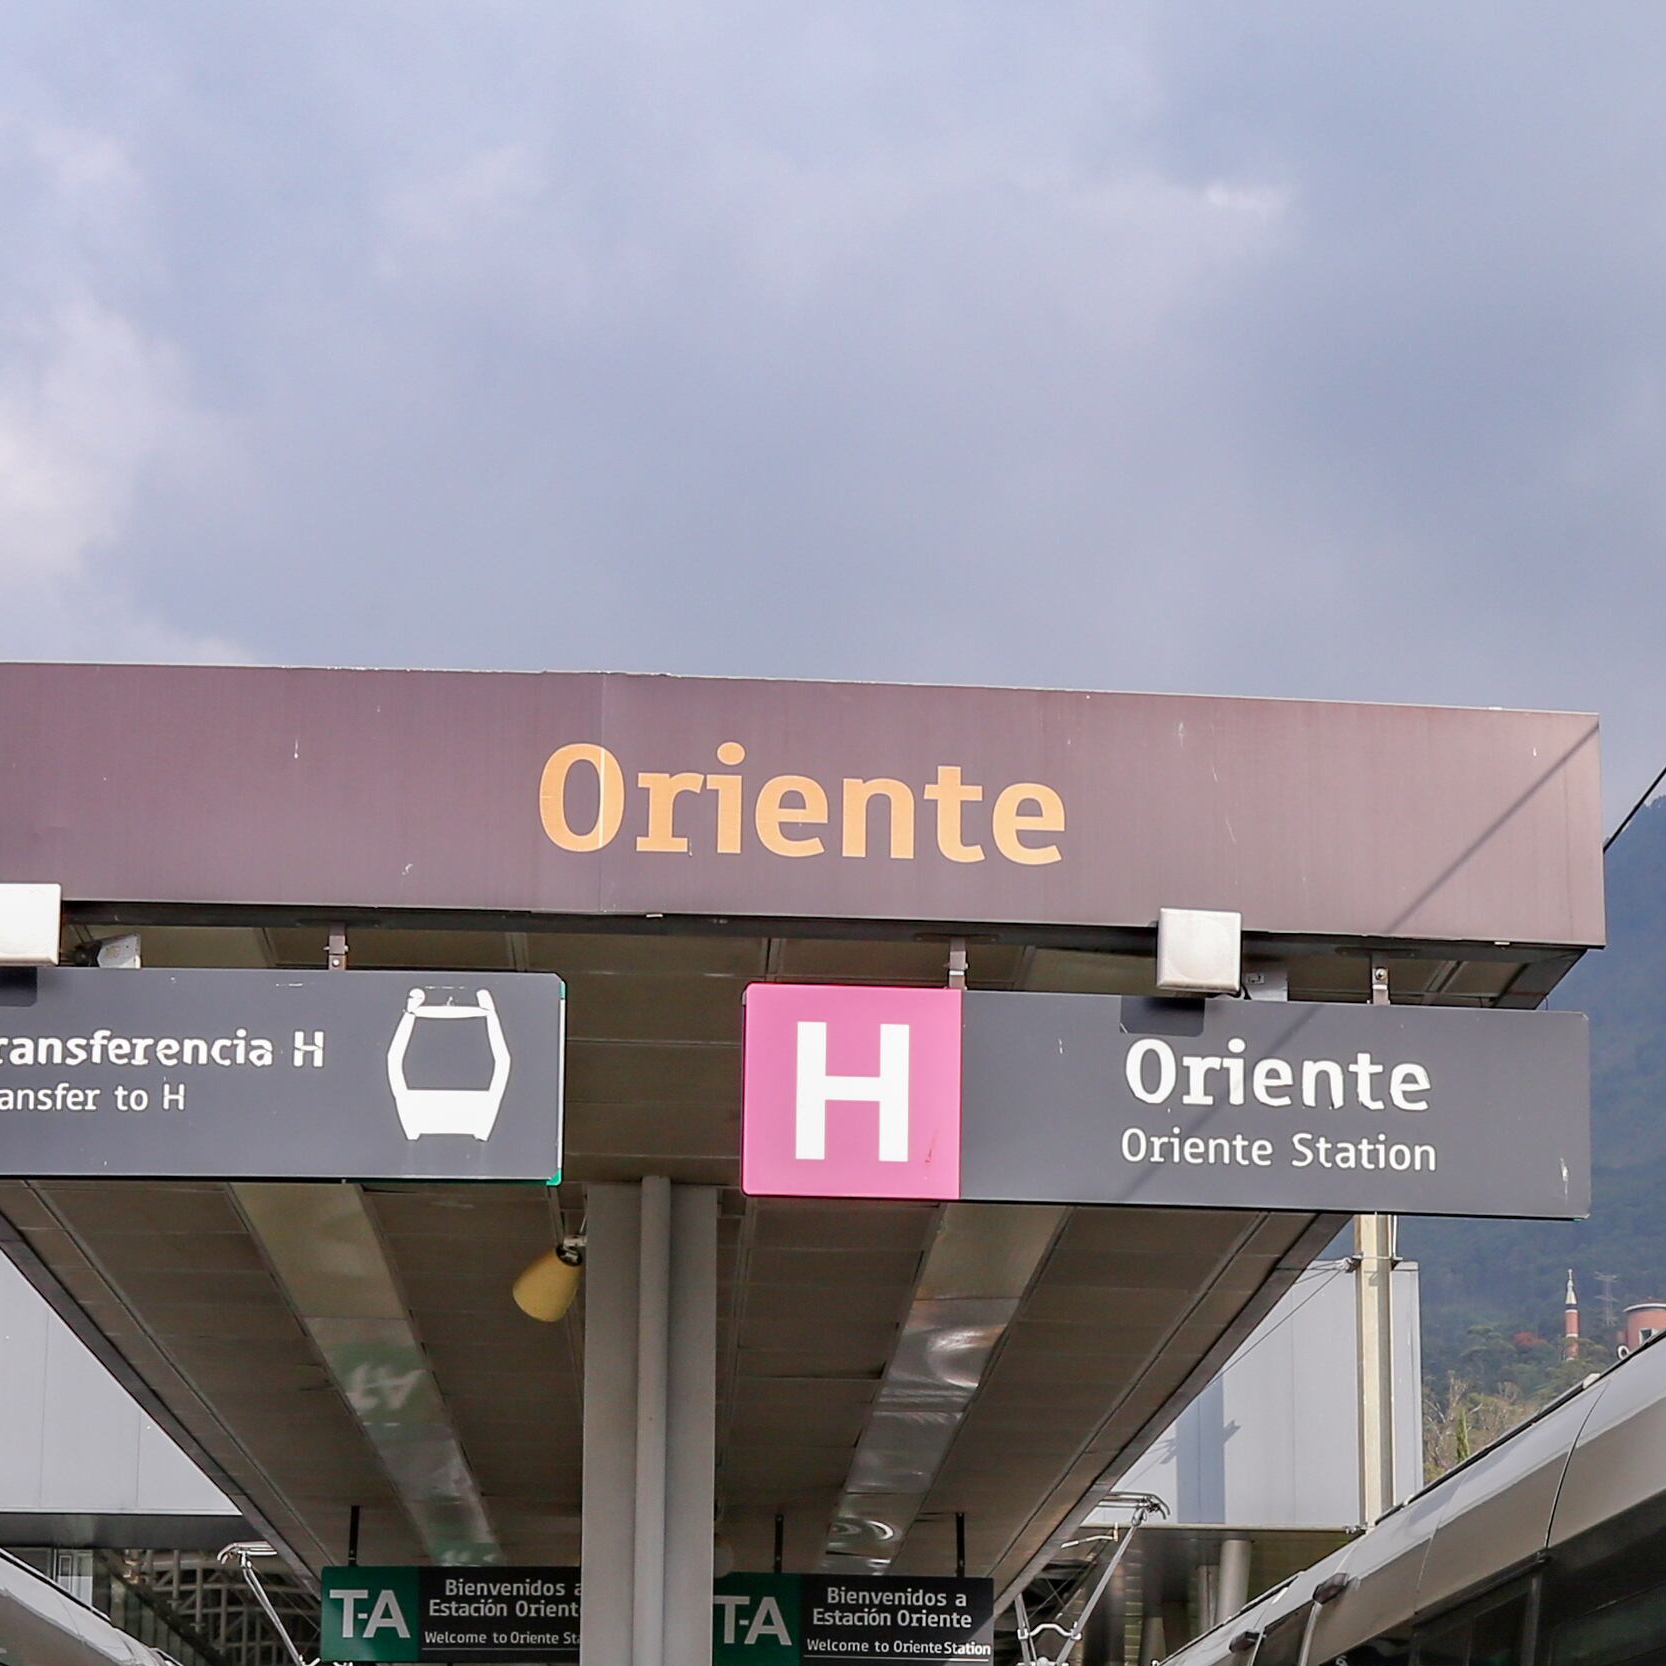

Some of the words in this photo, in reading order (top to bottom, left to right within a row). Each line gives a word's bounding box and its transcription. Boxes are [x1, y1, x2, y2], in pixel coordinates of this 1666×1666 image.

[539, 743, 1066, 866] Oriente
[293, 1031, 325, 1067] H
[1126, 1038, 1431, 1110] Oriente
[114, 1085, 149, 1111] to
[163, 1083, 185, 1110] H
[795, 1021, 910, 1162] H
[1121, 1126, 1273, 1166] Oriente
[1291, 1132, 1437, 1171] Station
[445, 1579, 565, 1596] Bienvenidos
[827, 1587, 947, 1606] Bienvenidos
[955, 1593, 967, 1607] a
[429, 1599, 507, 1617] Estación
[515, 1600, 581, 1617] Orient
[813, 1608, 891, 1626] Estación
[897, 1610, 972, 1628] Oriente
[425, 1631, 487, 1644] Welcome
[493, 1631, 507, 1644] to
[510, 1631, 559, 1645] Oriente
[807, 1639, 869, 1652] Welcome
[874, 1640, 889, 1652] to
[893, 1640, 942, 1654] Oriente
[943, 1641, 991, 1656] Station
